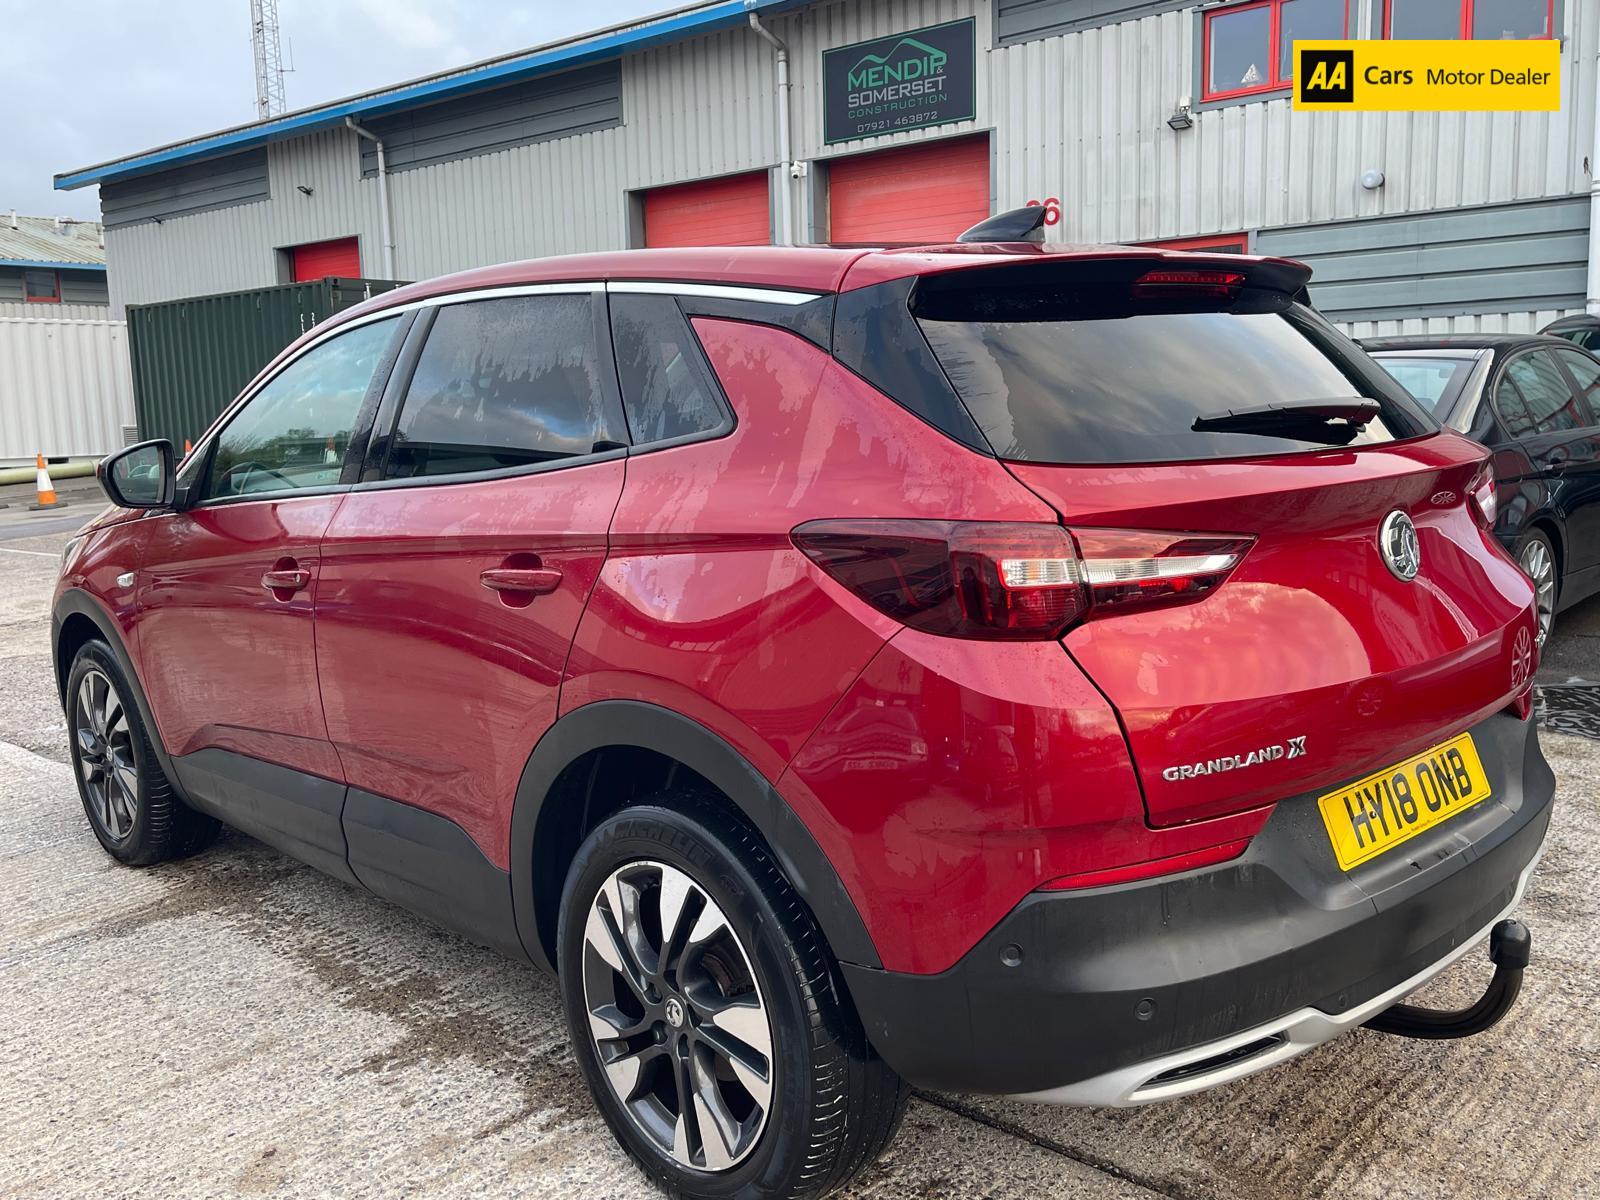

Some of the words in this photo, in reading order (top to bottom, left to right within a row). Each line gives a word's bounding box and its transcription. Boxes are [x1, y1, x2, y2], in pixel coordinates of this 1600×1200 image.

[848, 53, 947, 91] MENDIP
[848, 75, 947, 108] SOMERSET
[848, 93, 948, 119] CONSTRUCTION
[857, 119, 891, 133] 07921
[894, 111, 938, 126] 463872
[1162, 745, 1284, 781] GRANDLAND
[1286, 735, 1307, 759] X
[1343, 773, 1419, 849] HY18
[1415, 747, 1472, 812] ONB
